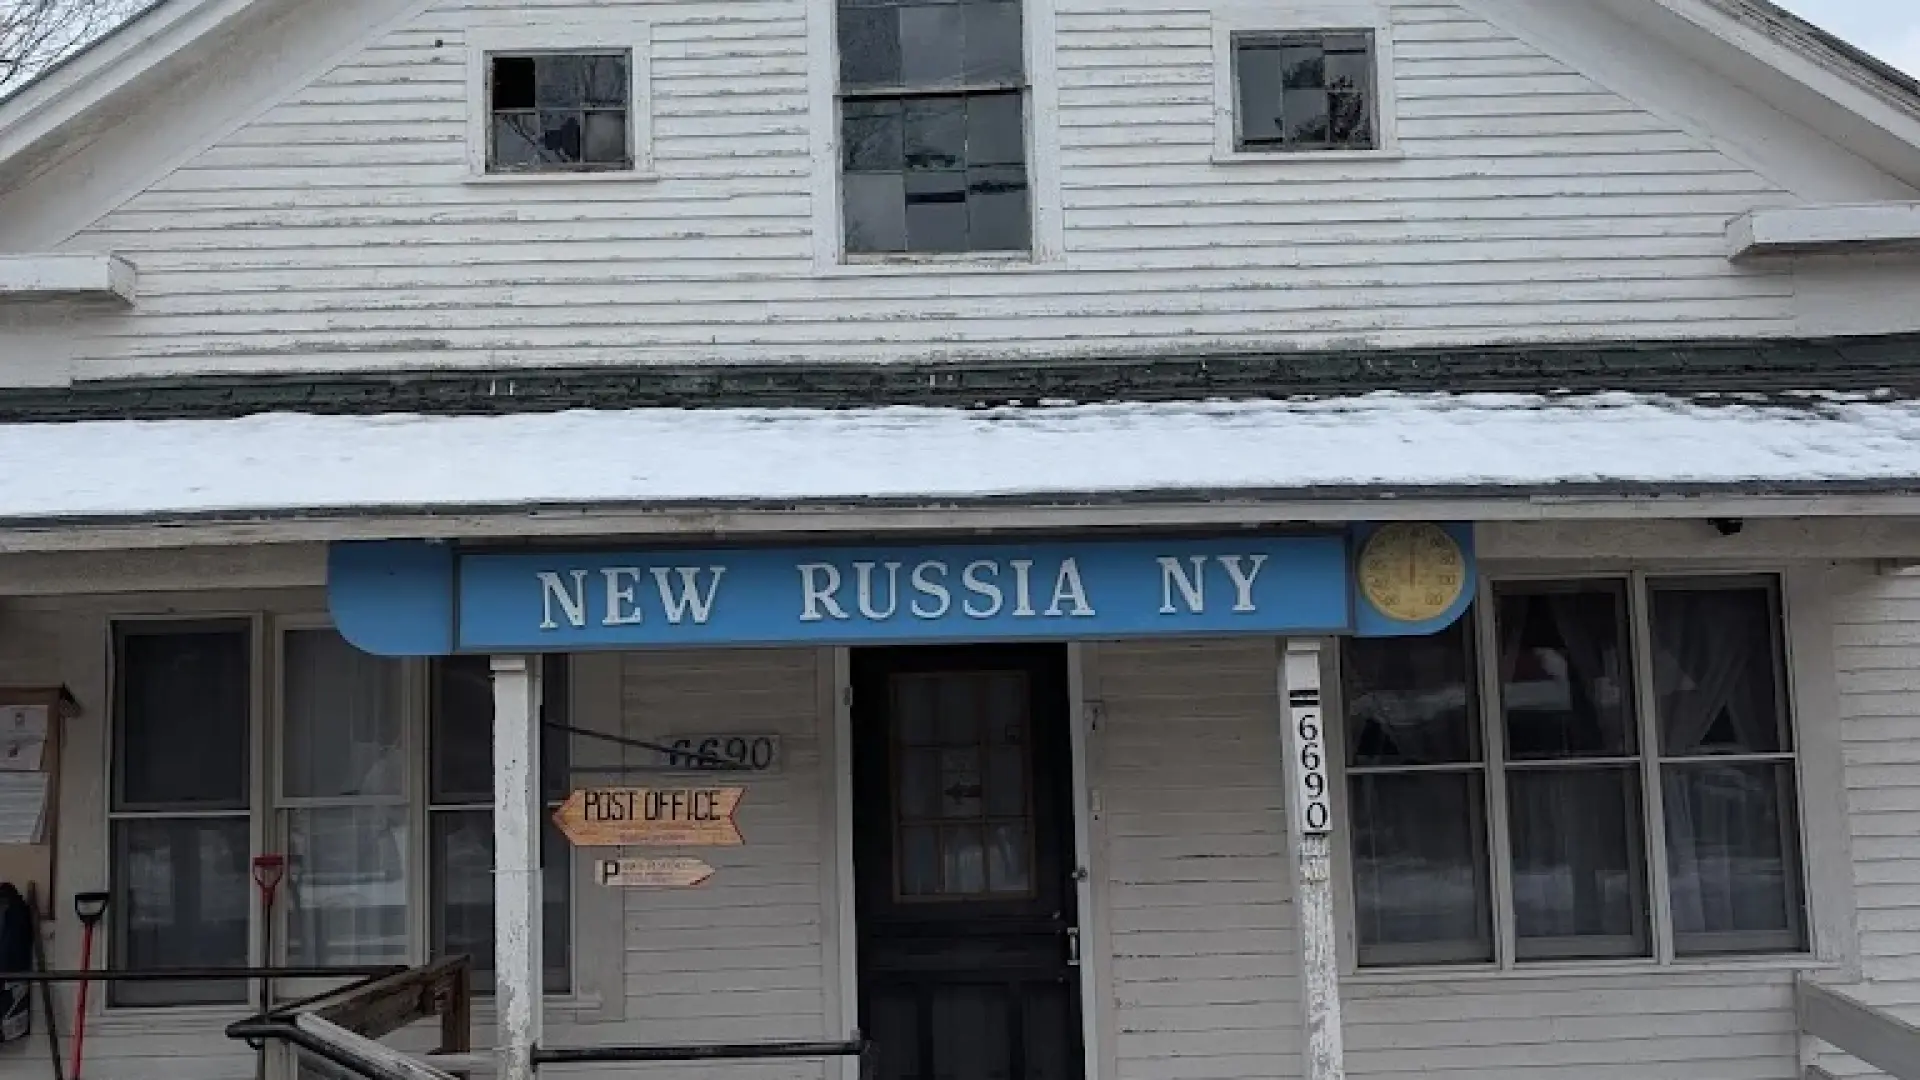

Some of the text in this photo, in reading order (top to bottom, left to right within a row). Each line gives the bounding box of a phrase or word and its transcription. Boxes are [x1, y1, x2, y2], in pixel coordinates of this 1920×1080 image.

[536, 554, 1268, 629] NEW RUSSIA NY
[584, 789, 721, 821] POST OFFICE
[1299, 714, 1328, 829] 6690
